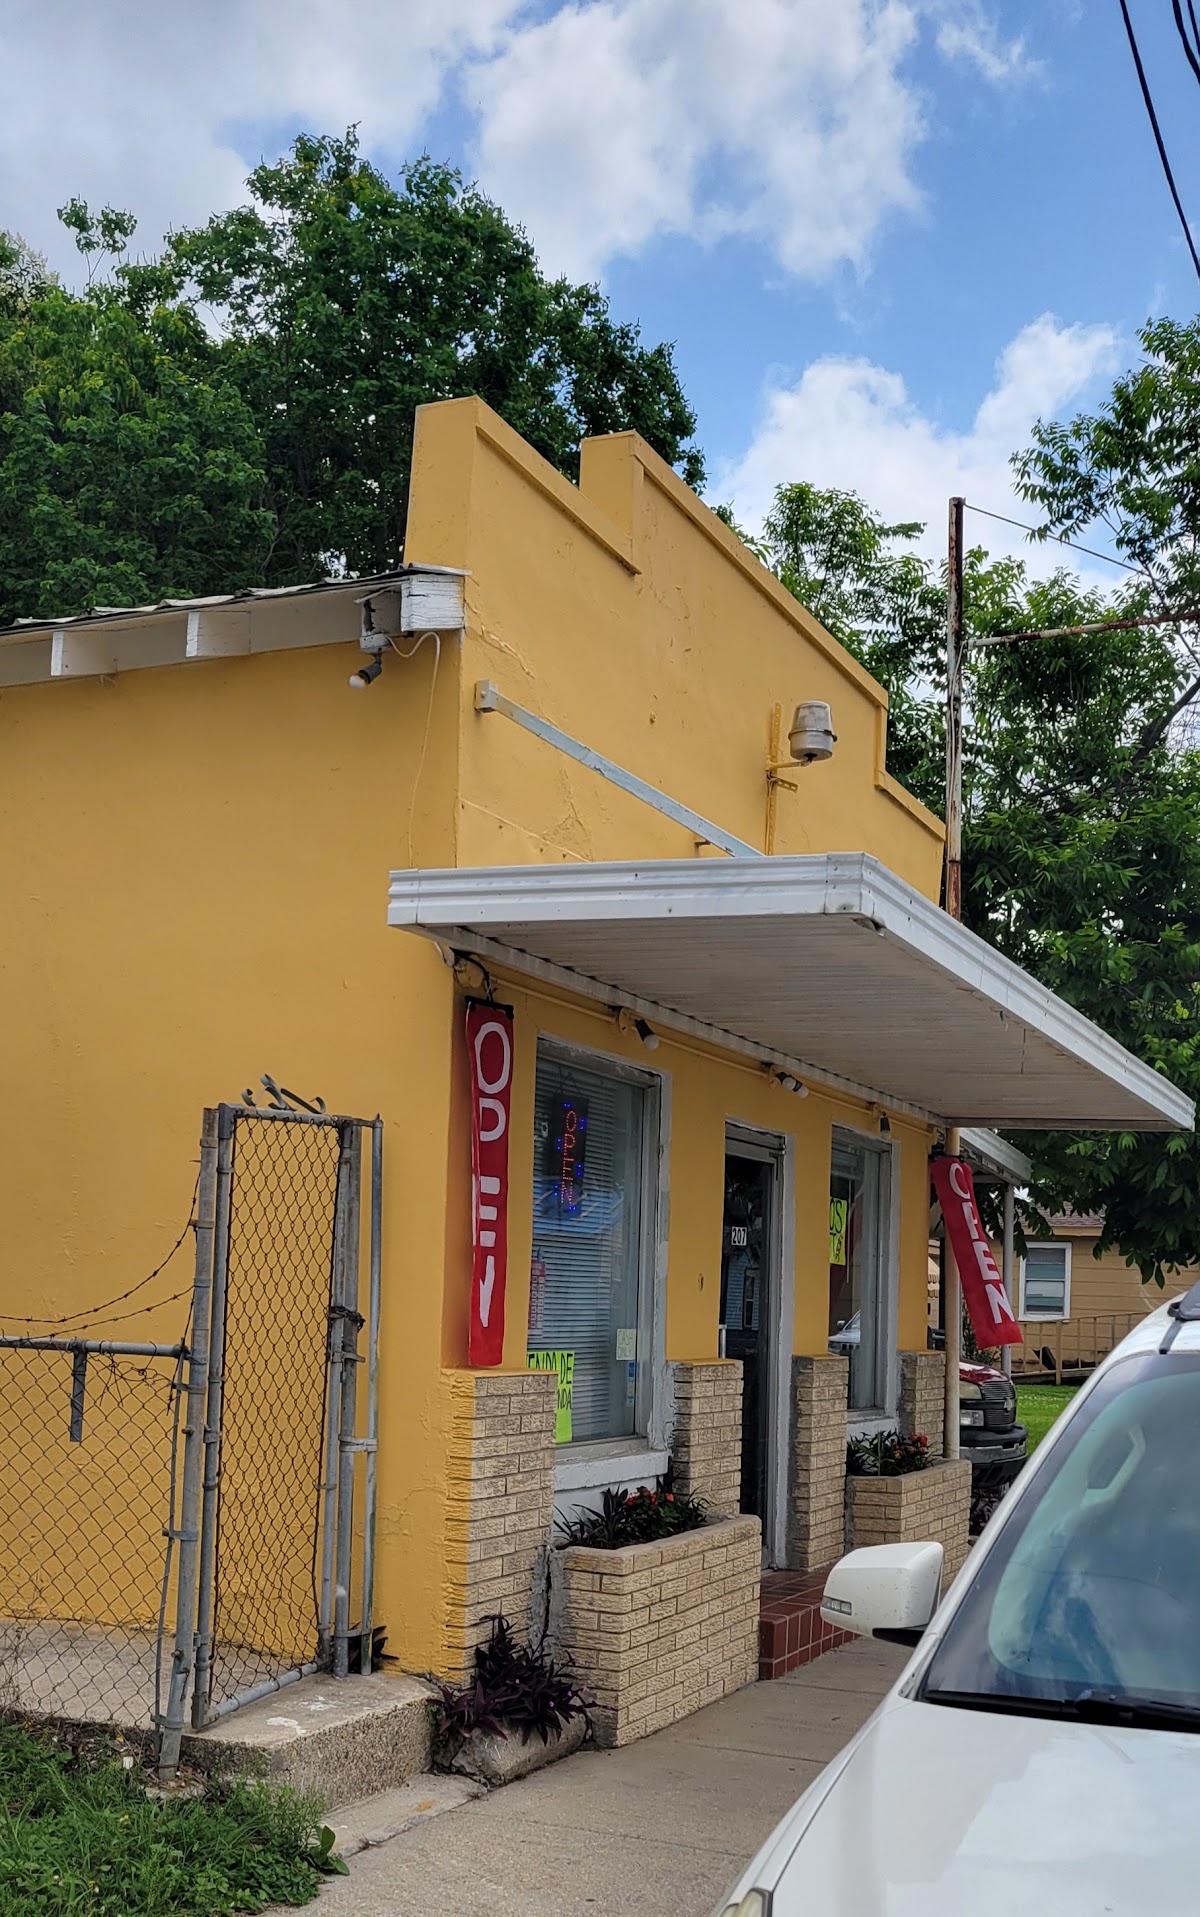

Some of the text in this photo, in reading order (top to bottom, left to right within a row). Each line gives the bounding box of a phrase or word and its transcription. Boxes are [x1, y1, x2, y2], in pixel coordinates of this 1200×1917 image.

[561, 1110, 577, 1204] OPEN
[732, 1227, 747, 1245] 207
[618, 1330, 633, 1346] CASH
[617, 1346, 632, 1359] ONLY
[527, 1352, 573, 1384] ENDO DE
